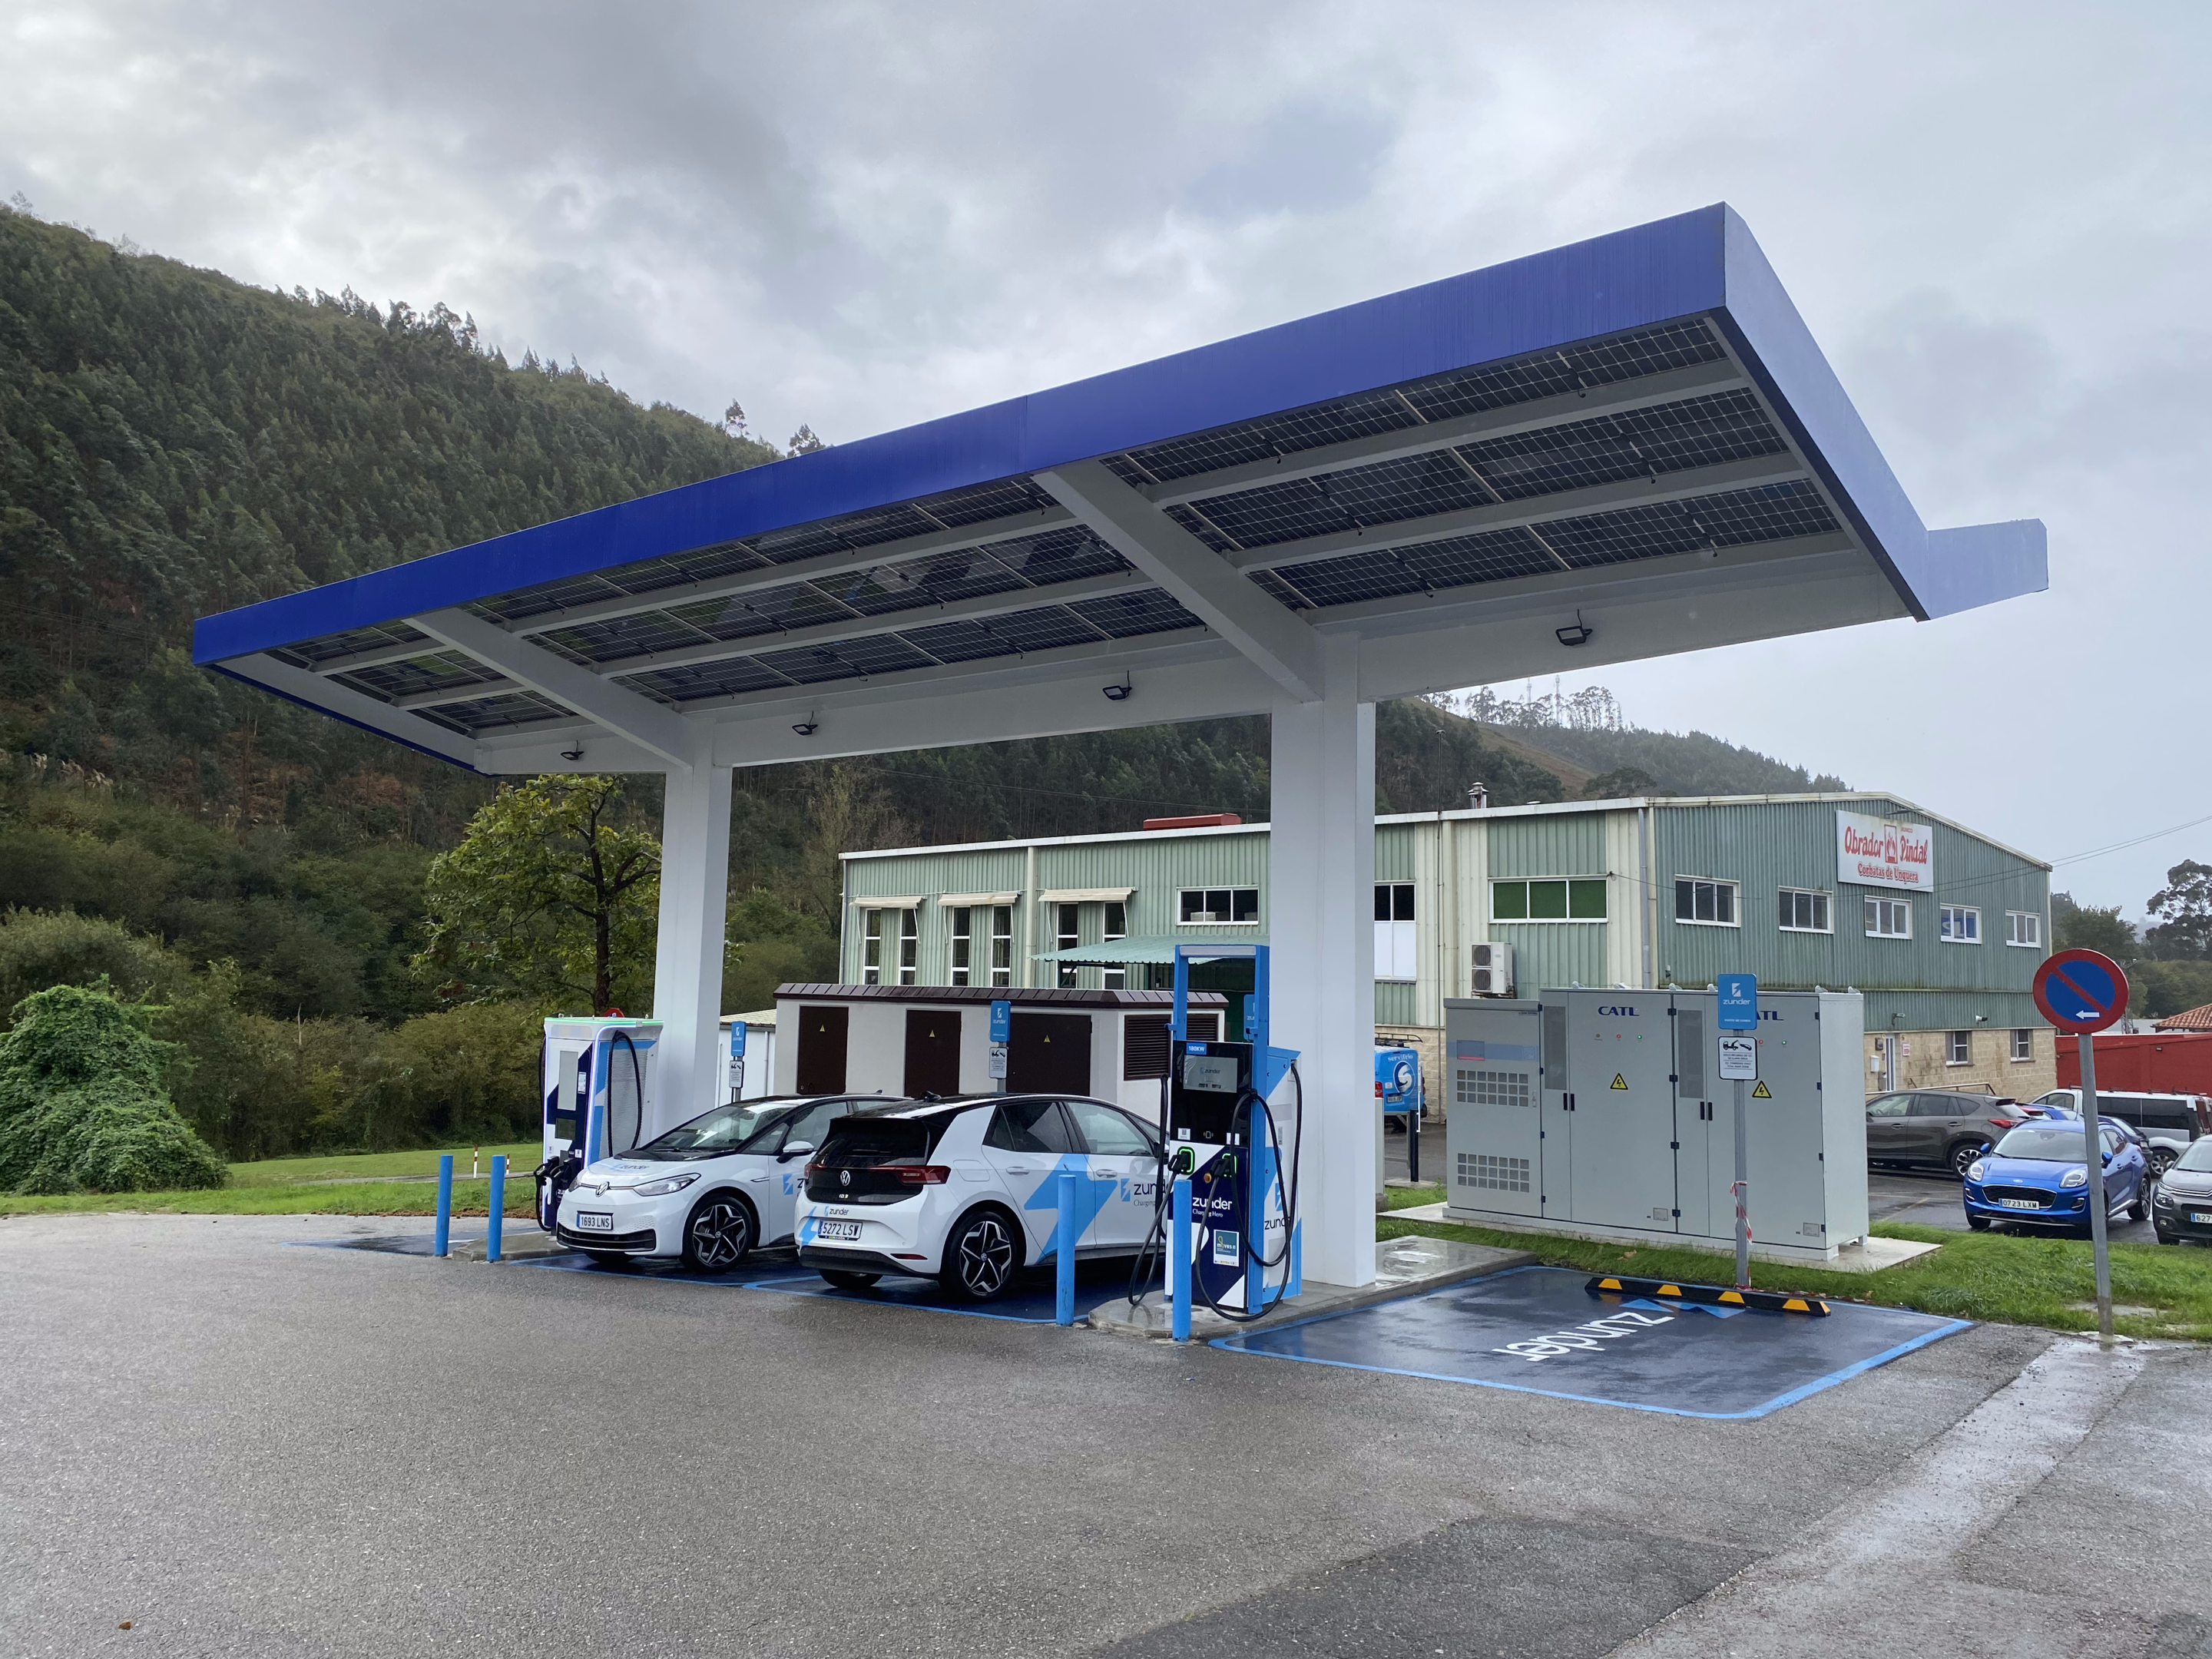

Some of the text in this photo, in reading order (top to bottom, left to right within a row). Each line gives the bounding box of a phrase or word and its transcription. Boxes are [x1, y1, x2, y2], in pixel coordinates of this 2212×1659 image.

[1844, 826, 1929, 865] Obrador Pindal
[1857, 861, 1919, 884] Corbatas de Unquera
[1598, 1006, 1640, 1017] CATL
[581, 1216, 610, 1227] 1693 LNS
[823, 1222, 842, 1235] 5272
[1492, 1312, 1675, 1362] zunder
